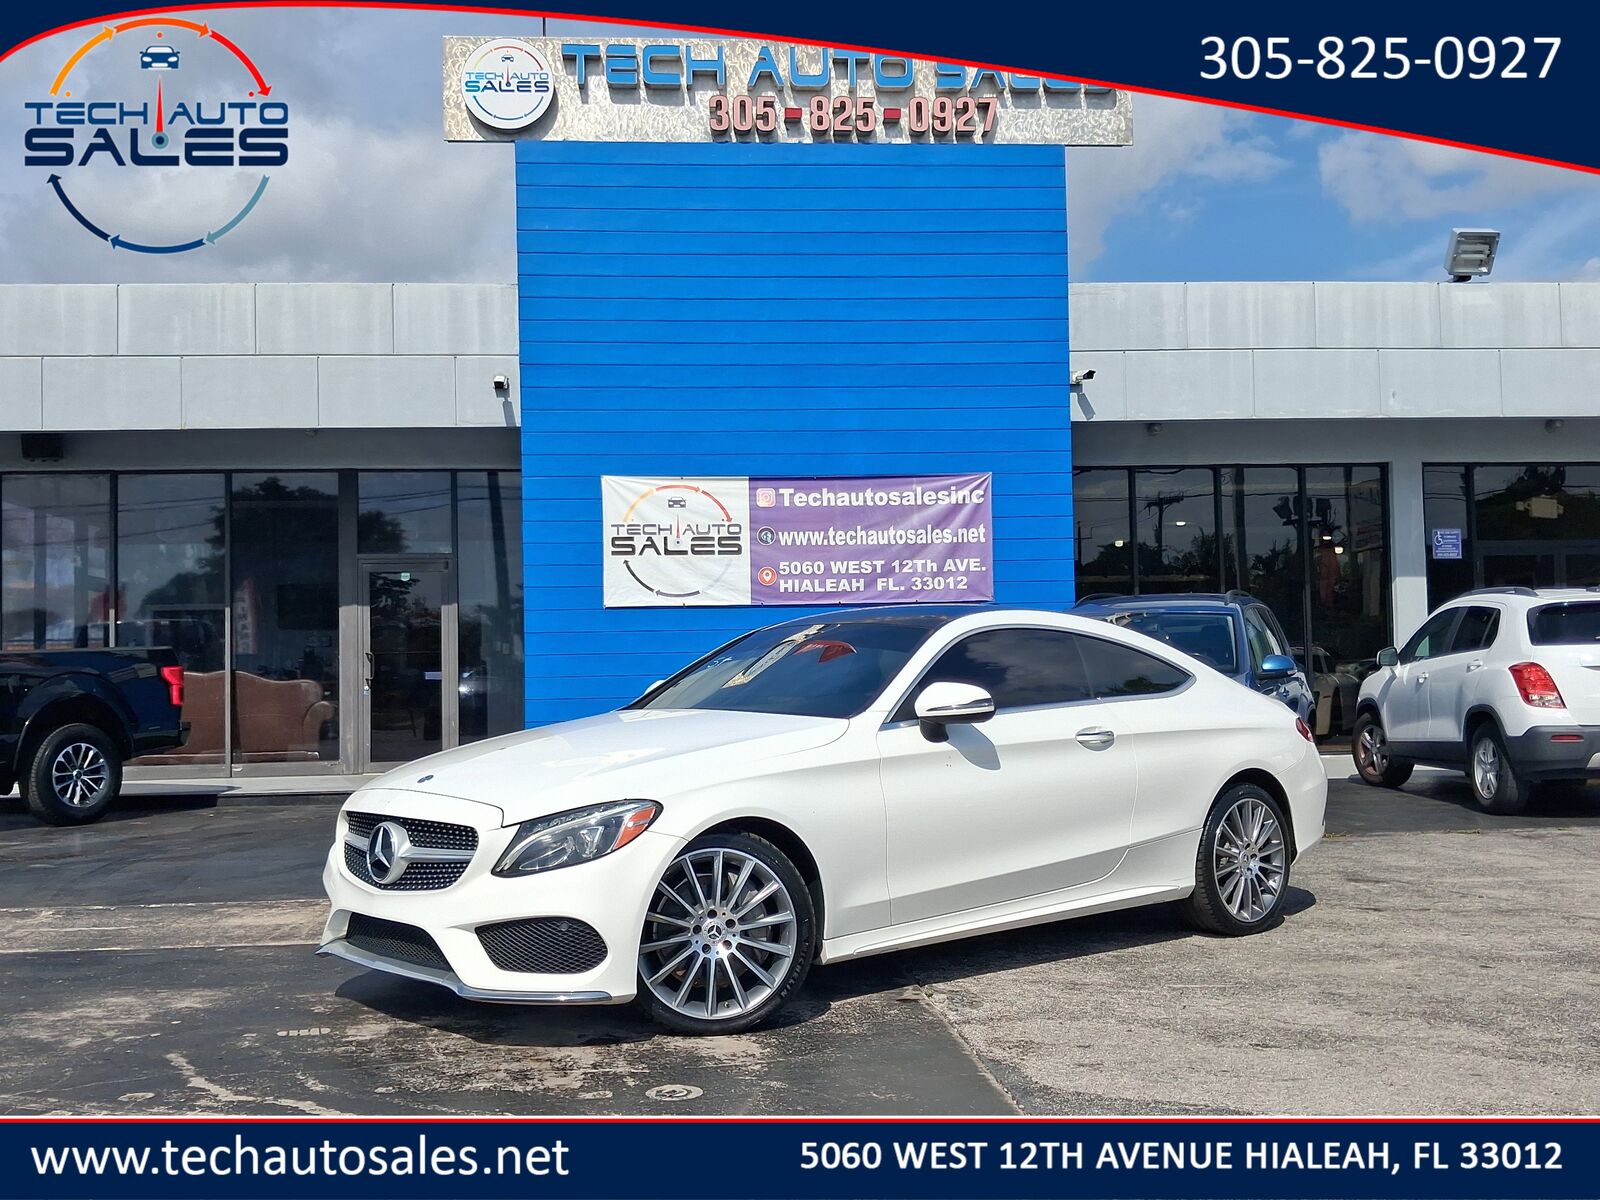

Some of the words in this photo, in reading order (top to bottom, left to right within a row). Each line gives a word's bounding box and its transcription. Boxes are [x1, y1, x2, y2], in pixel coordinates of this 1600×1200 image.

[561, 44, 725, 86] TECH
[748, 46, 914, 88] AUTO
[465, 72, 504, 80] TECH
[510, 72, 549, 80] AUTO
[464, 80, 550, 93] SALES
[709, 95, 999, 134] 305-825-0927
[779, 486, 985, 507] Techautosalesinc
[611, 524, 672, 536] TECH
[682, 524, 742, 536] AUTO
[778, 523, 986, 546] www.techautosales.net
[611, 536, 743, 556] SALES
[779, 561, 825, 575] 5060
[830, 560, 885, 574] WEST
[891, 559, 938, 573] 12Th
[943, 558, 987, 573] AVE.
[779, 578, 865, 592] HIALEAH
[877, 577, 905, 591] FL.
[911, 576, 968, 590] 33012
